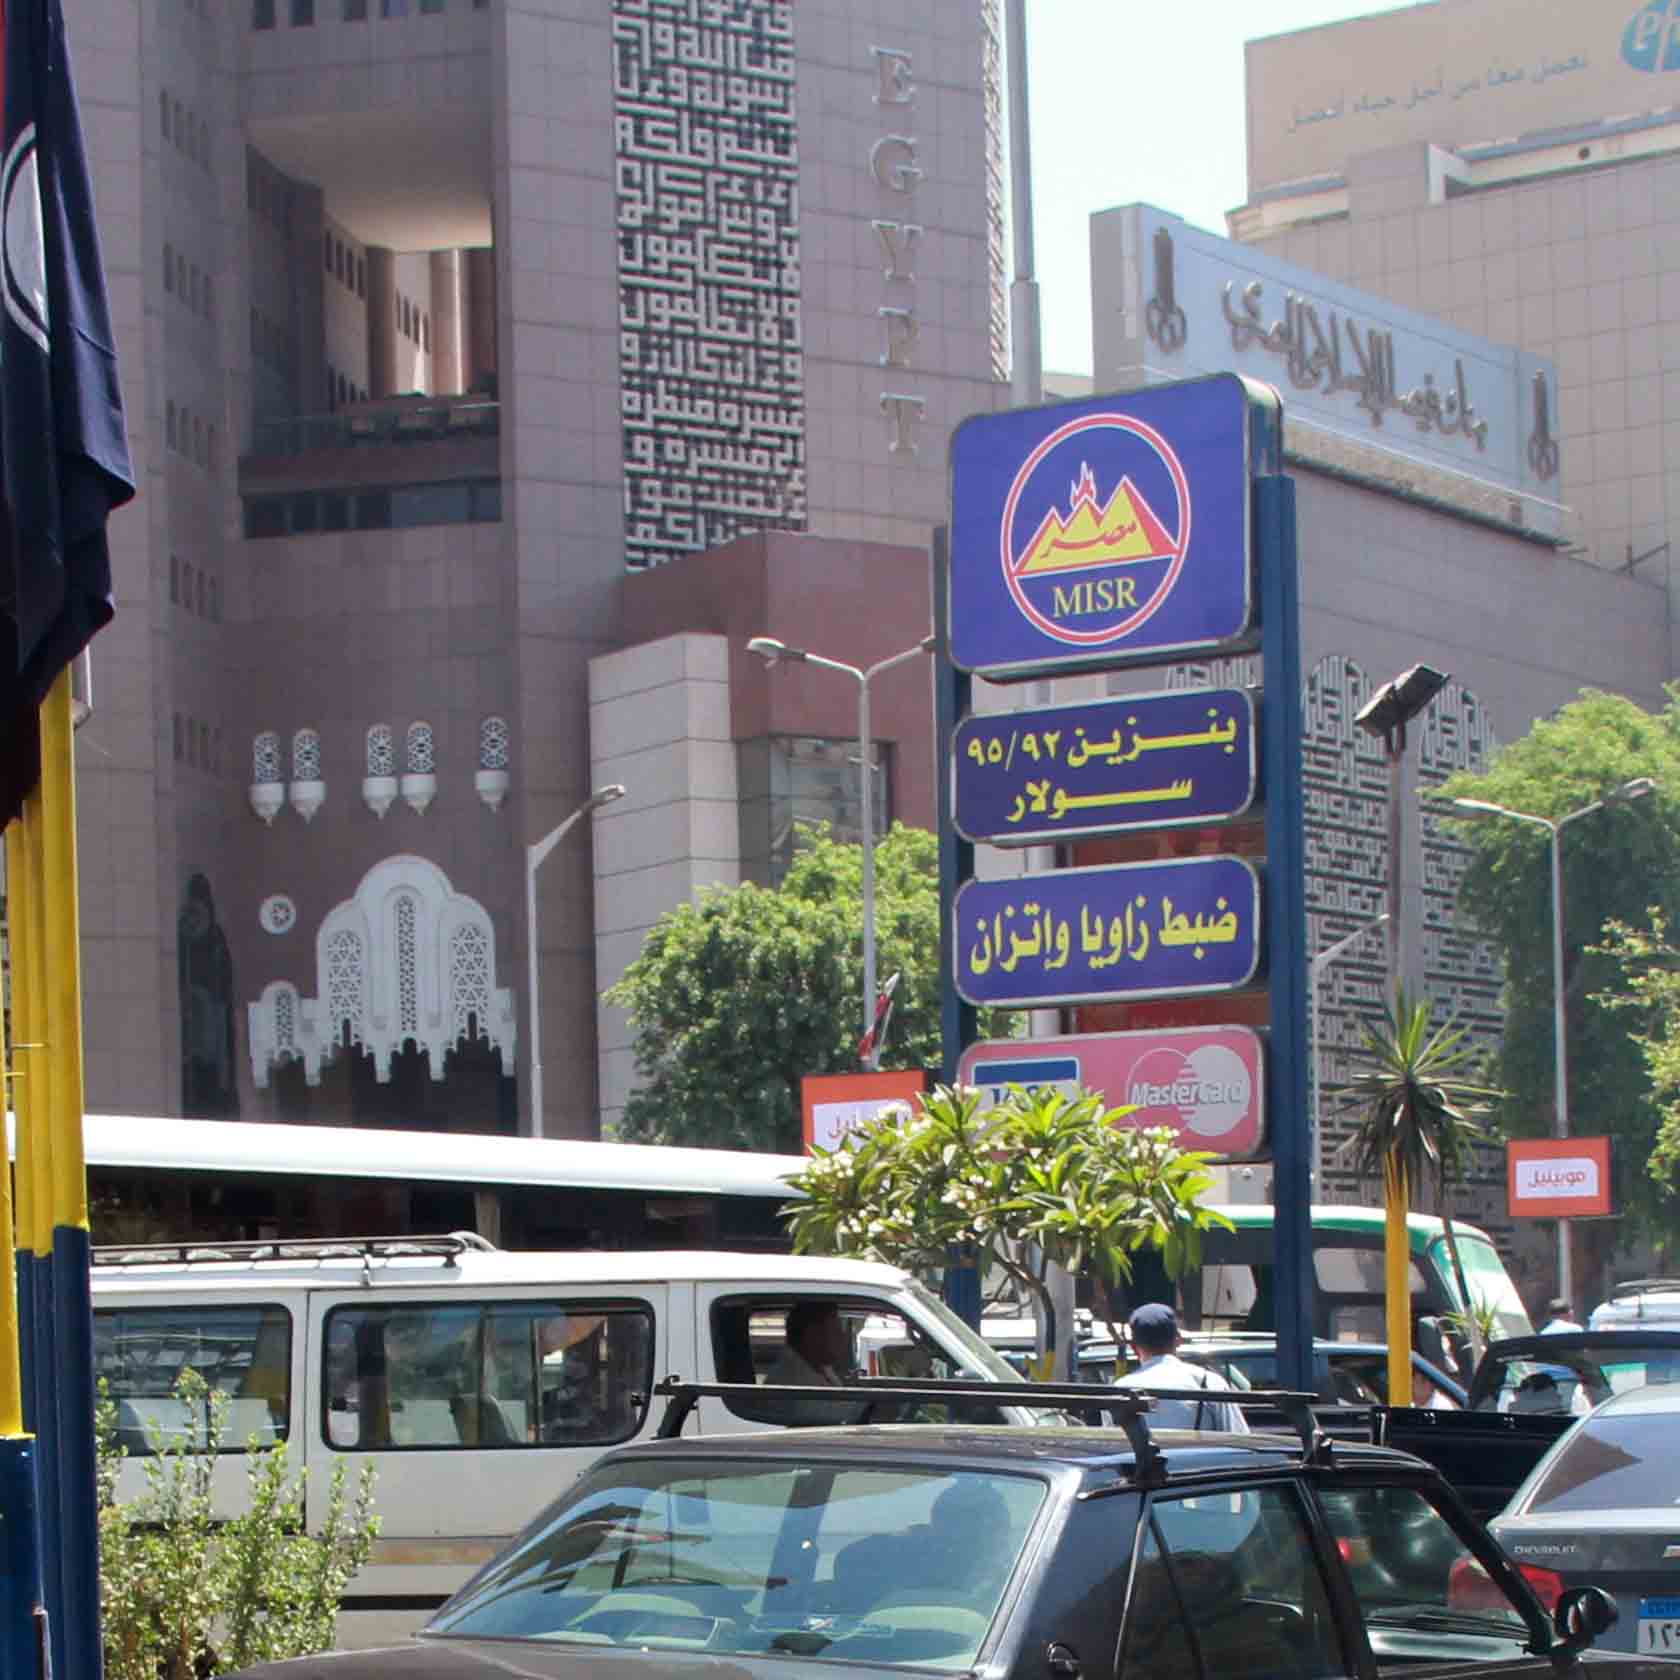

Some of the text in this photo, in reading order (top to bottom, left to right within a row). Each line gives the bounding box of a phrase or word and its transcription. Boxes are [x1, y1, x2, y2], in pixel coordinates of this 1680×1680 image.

[1052, 577, 1138, 619] MISR
[1067, 708, 1237, 768] بنزين
[1005, 777, 1193, 823] سولار
[1158, 896, 1238, 960] ضبط
[1130, 1077, 1243, 1108] MasterCard
